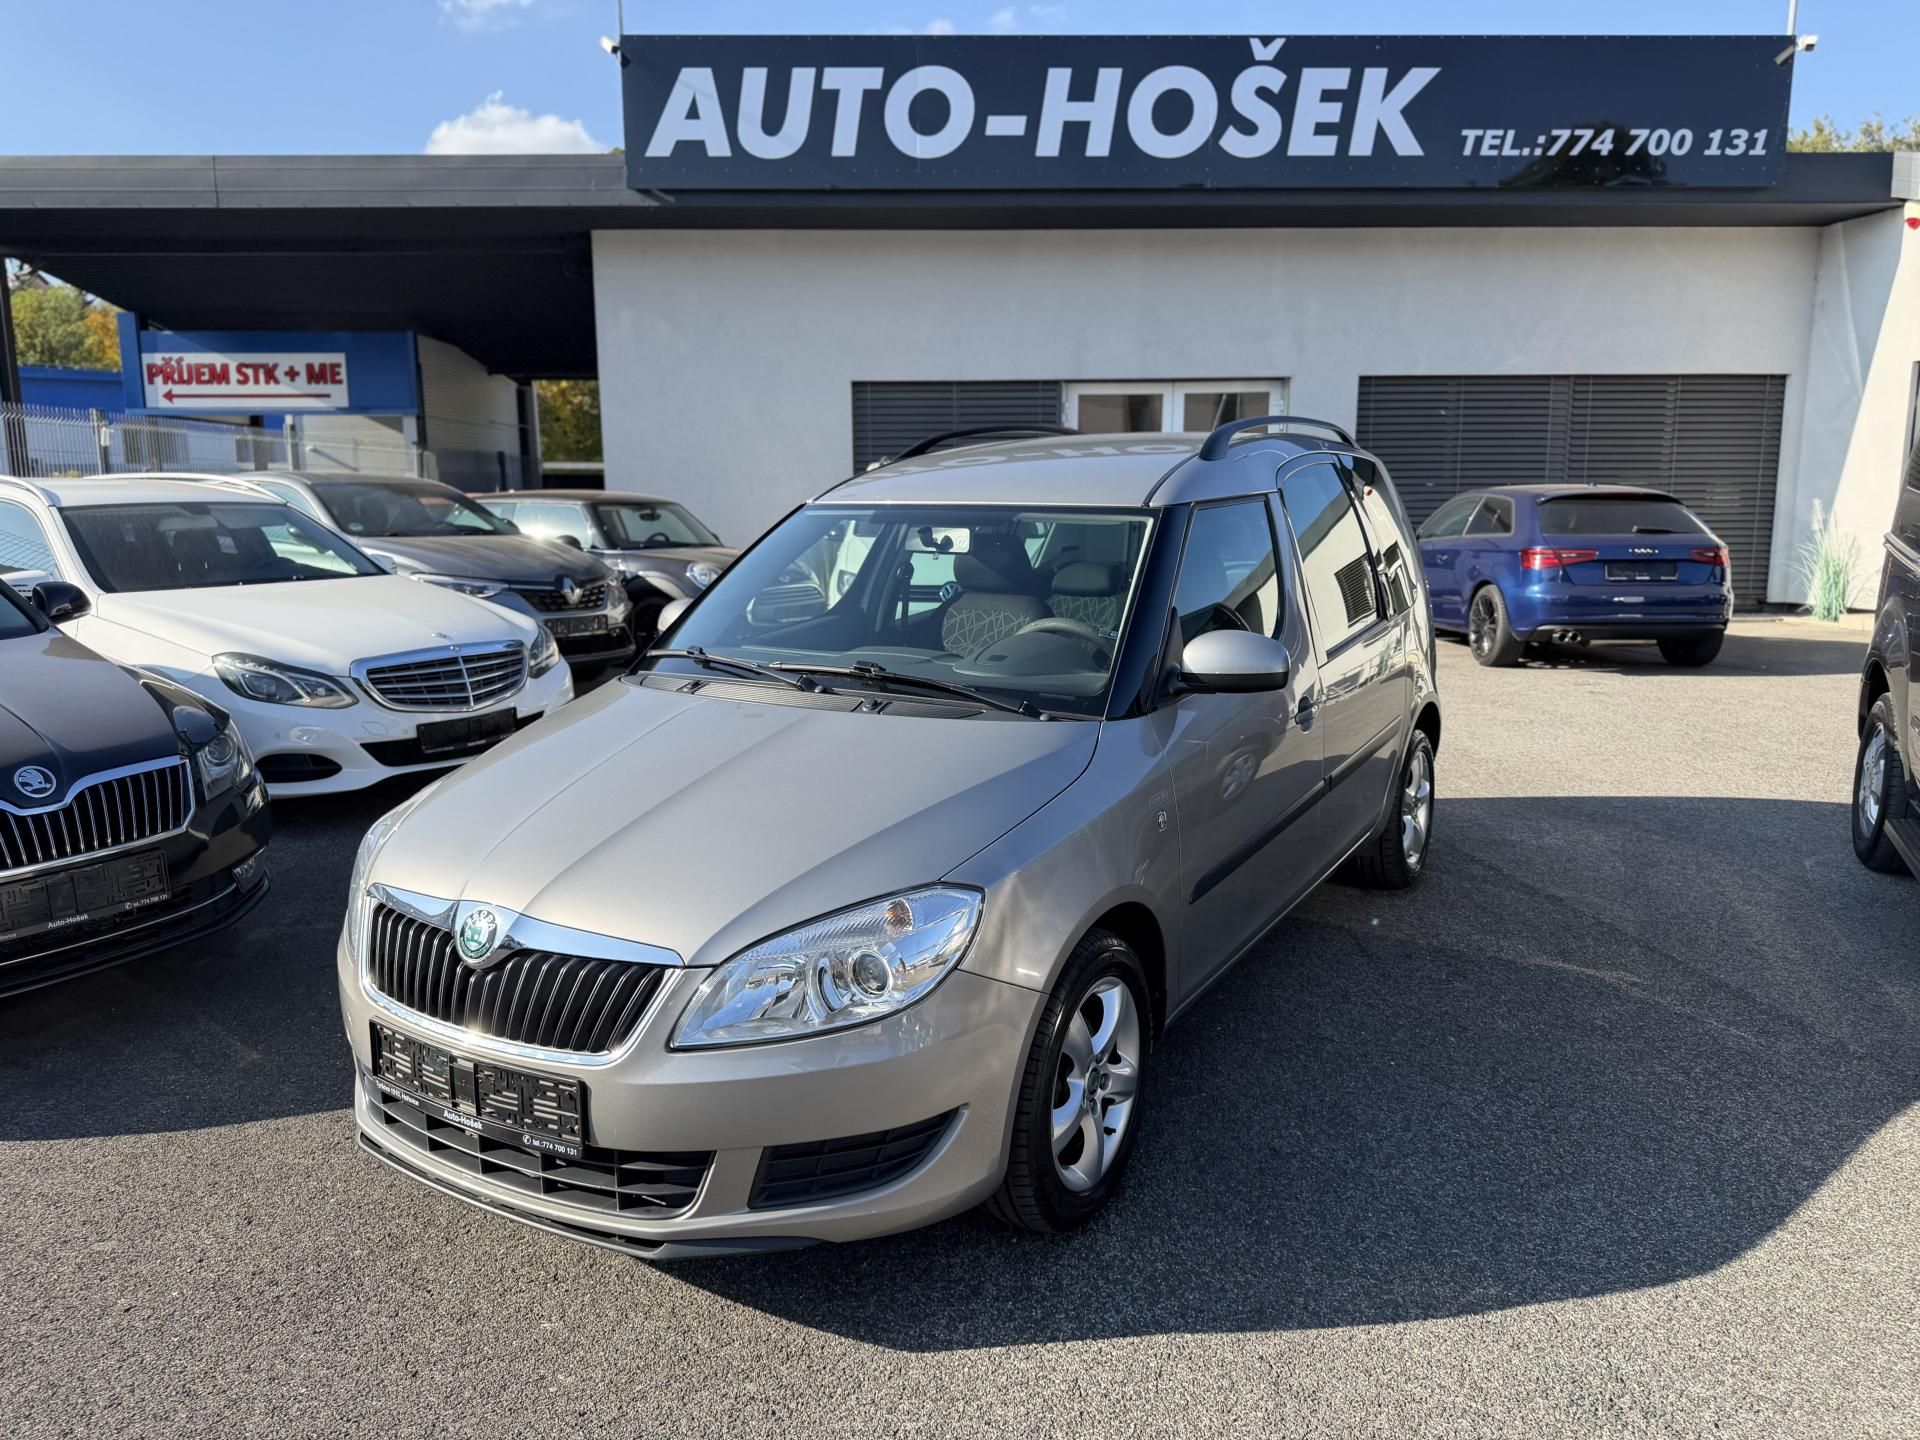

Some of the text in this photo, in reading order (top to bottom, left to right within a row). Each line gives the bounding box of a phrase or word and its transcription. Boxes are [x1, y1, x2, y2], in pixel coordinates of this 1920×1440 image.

[645, 37, 1442, 160] AUTO-HOŠEK
[1460, 128, 1768, 157] TEL.:774 700 131
[146, 356, 344, 386] PŘÍJEM STK + ME
[443, 1109, 483, 1131] Auto-Hošek
[554, 1144, 566, 1153] 700
[566, 1147, 578, 1156] 131
